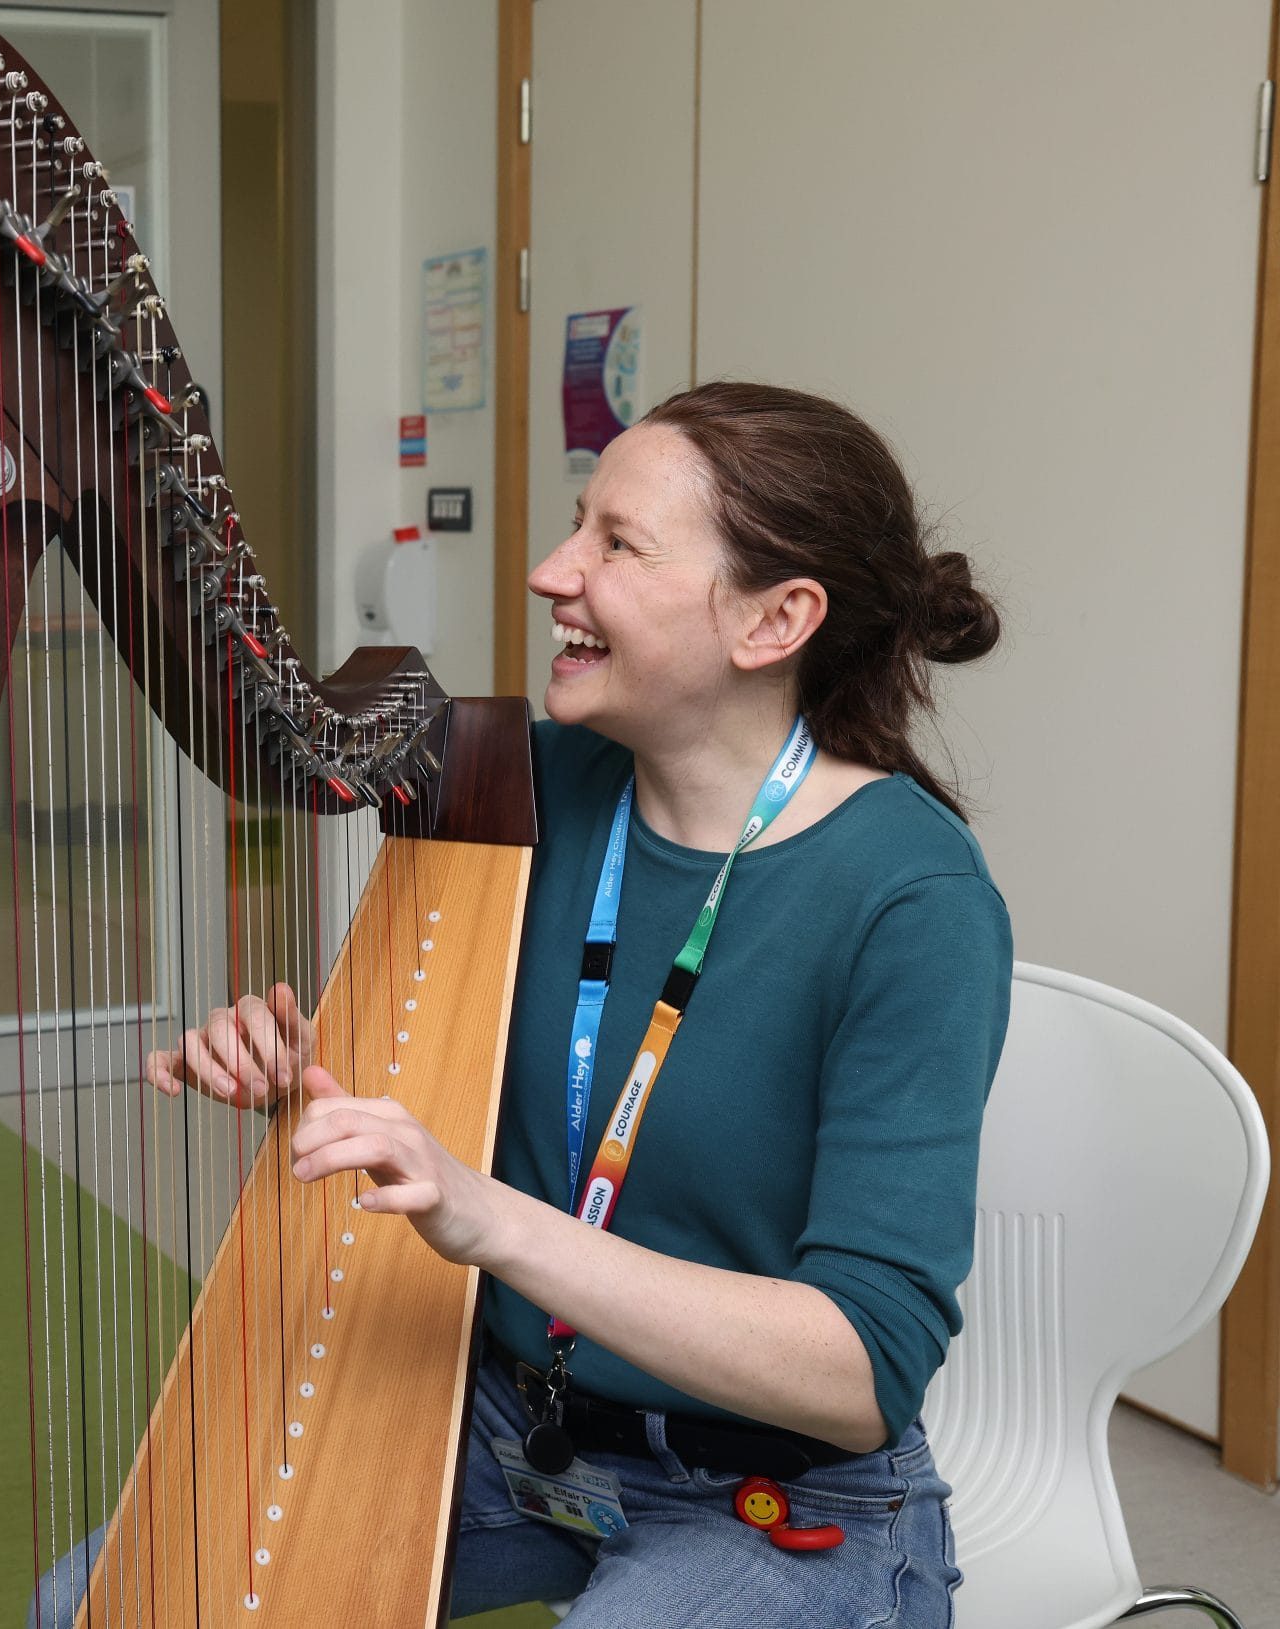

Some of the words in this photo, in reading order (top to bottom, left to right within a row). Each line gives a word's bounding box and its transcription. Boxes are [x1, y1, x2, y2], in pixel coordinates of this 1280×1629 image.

[609, 853, 619, 871] Hey
[604, 871, 616, 897] Alder
[572, 1059, 590, 1091] Hey
[570, 1093, 583, 1132] Alder
[615, 1079, 642, 1137] COURAGE
